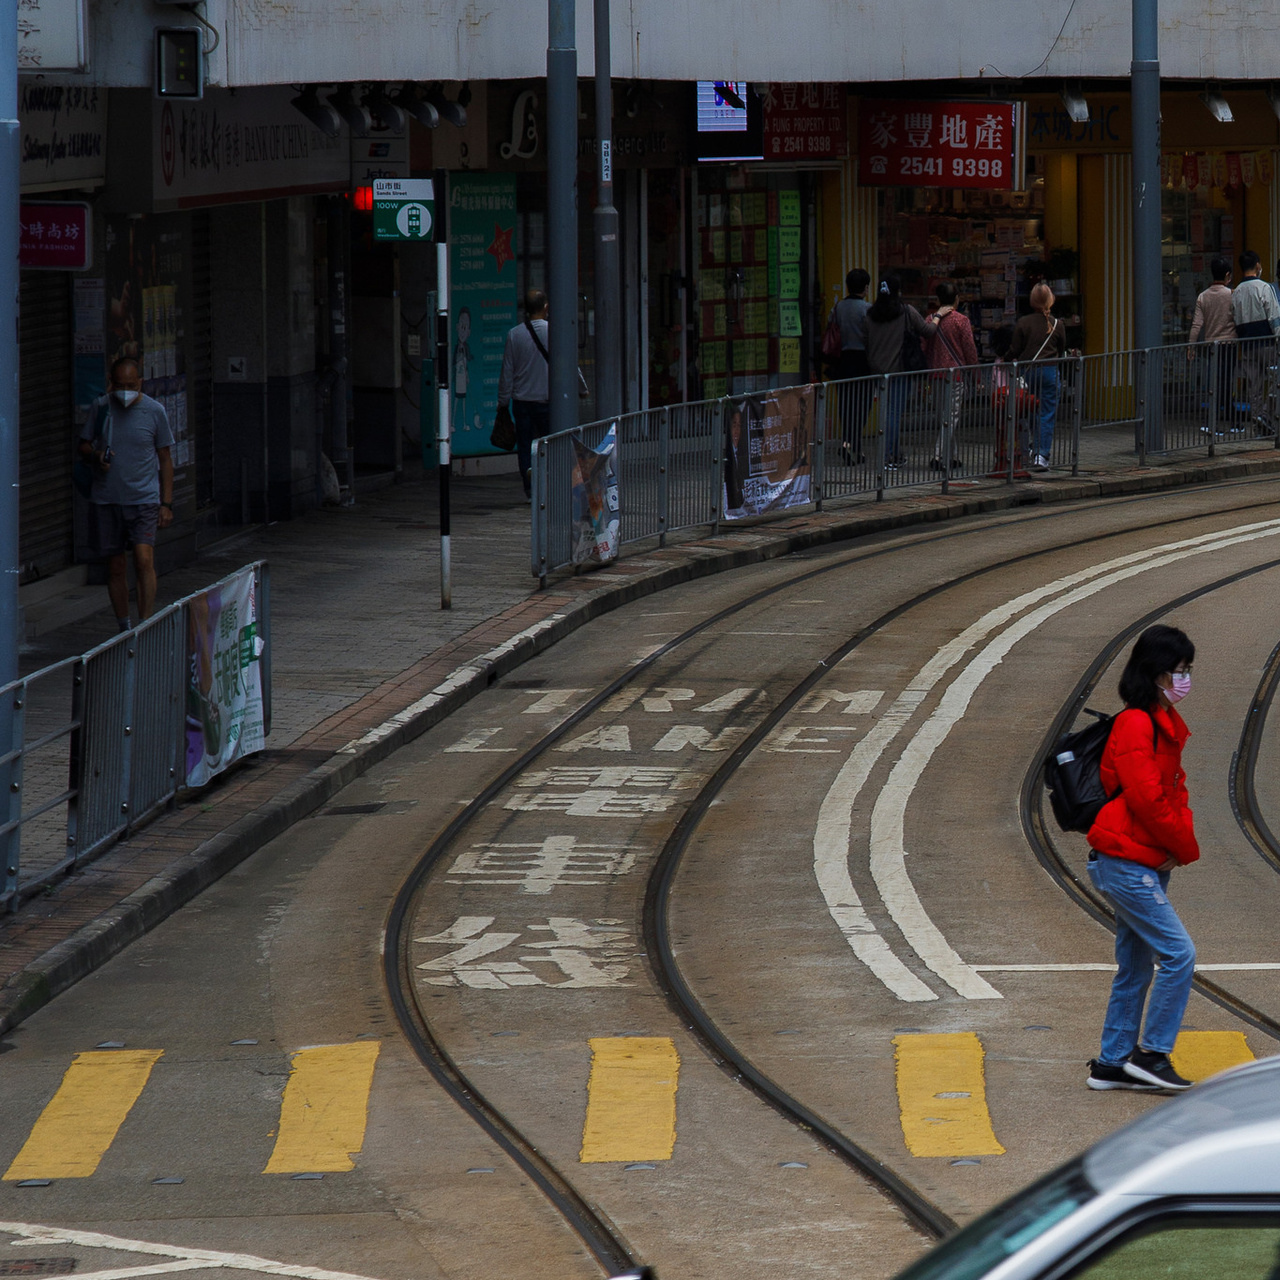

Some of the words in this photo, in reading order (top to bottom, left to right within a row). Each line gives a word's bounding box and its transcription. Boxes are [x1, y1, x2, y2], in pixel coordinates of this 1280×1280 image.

[794, 118, 824, 132] PROPERTY
[870, 113, 1004, 151] 家豐地產
[784, 137, 804, 152] 2541
[808, 135, 831, 152] 9398
[900, 157, 942, 176] 2541
[952, 159, 1003, 178] 9398
[376, 202, 399, 210] 100W
[20, 221, 80, 240] 時尚坊
